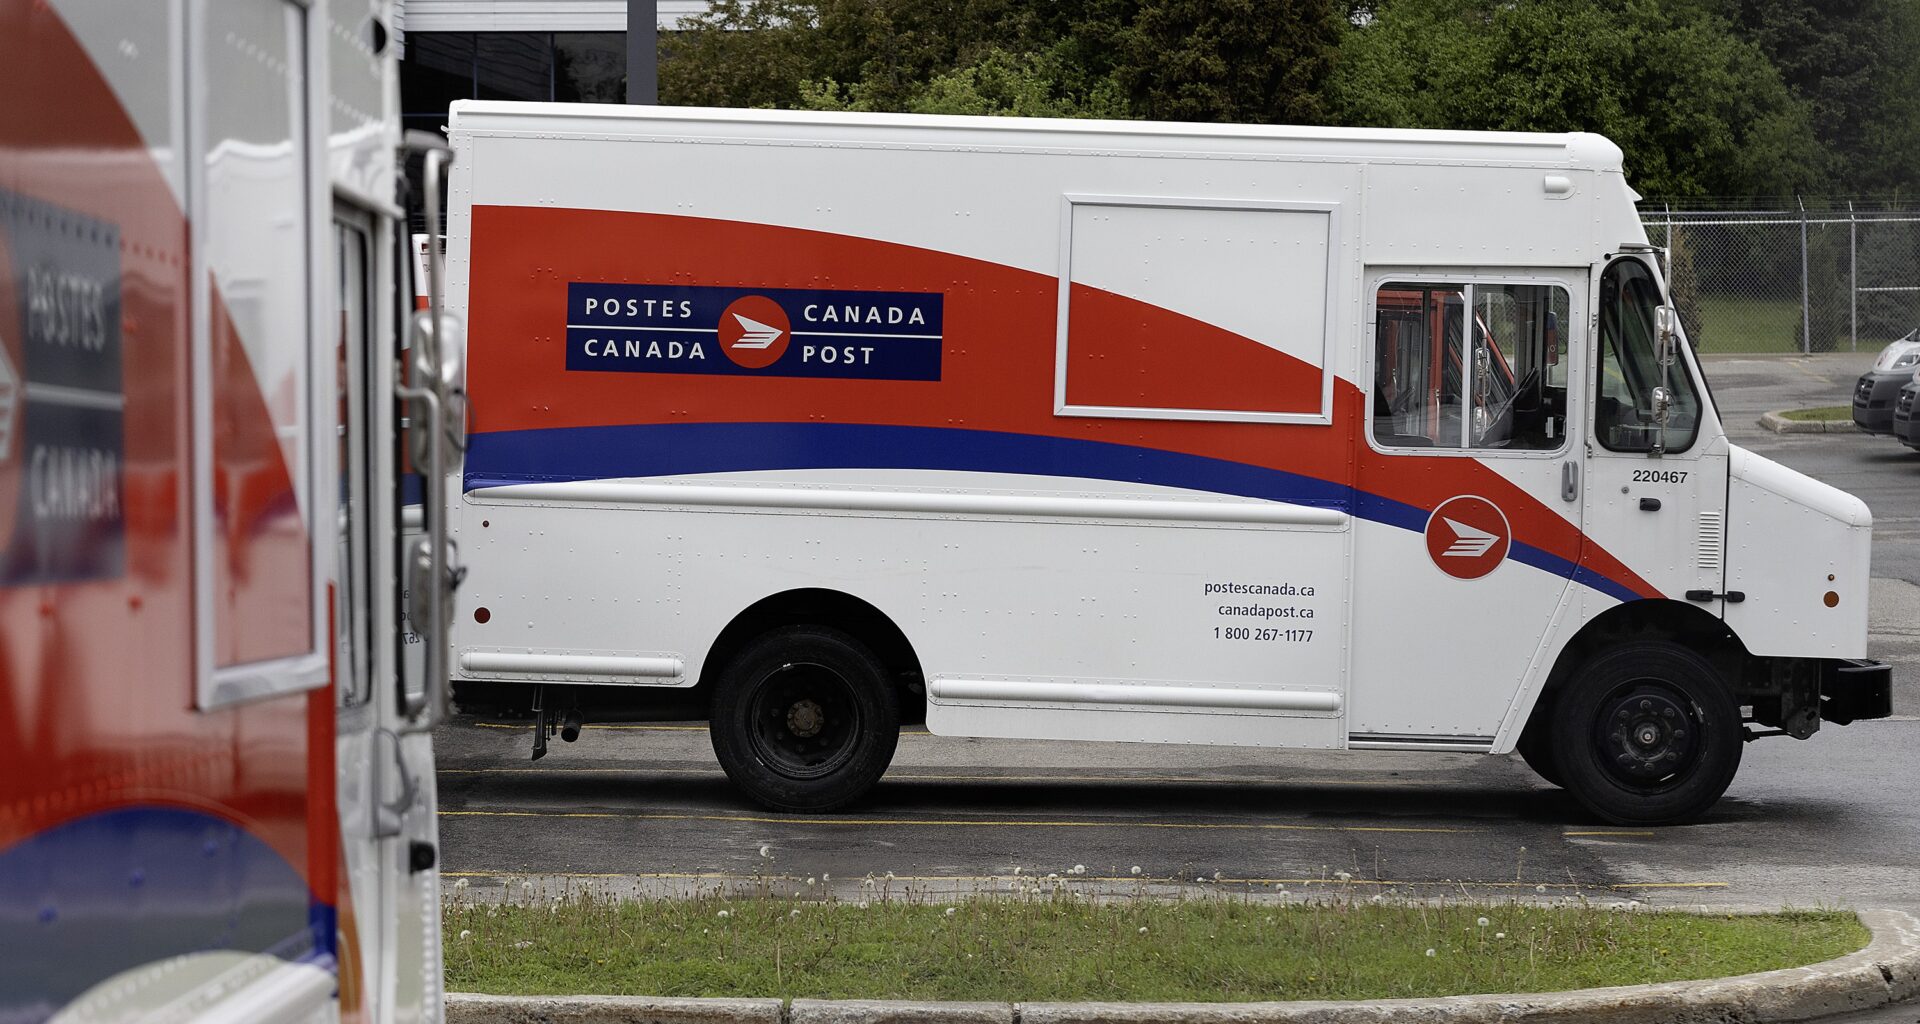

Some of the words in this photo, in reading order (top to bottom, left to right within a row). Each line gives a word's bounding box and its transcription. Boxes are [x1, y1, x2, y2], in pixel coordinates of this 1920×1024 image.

[27, 266, 105, 350] POSTES
[585, 297, 692, 318] POSTES
[803, 304, 925, 325] CANADA
[584, 339, 705, 360] CANADA
[803, 345, 874, 365] POST
[30, 444, 121, 520] CANADA
[1632, 469, 1688, 484] 220467
[1204, 582, 1315, 597] postescanada.ca
[1218, 603, 1314, 620] canadapost.ca
[1213, 626, 1220, 639] 1
[1224, 627, 1250, 640] 800
[1254, 628, 1313, 642] 267-1177
